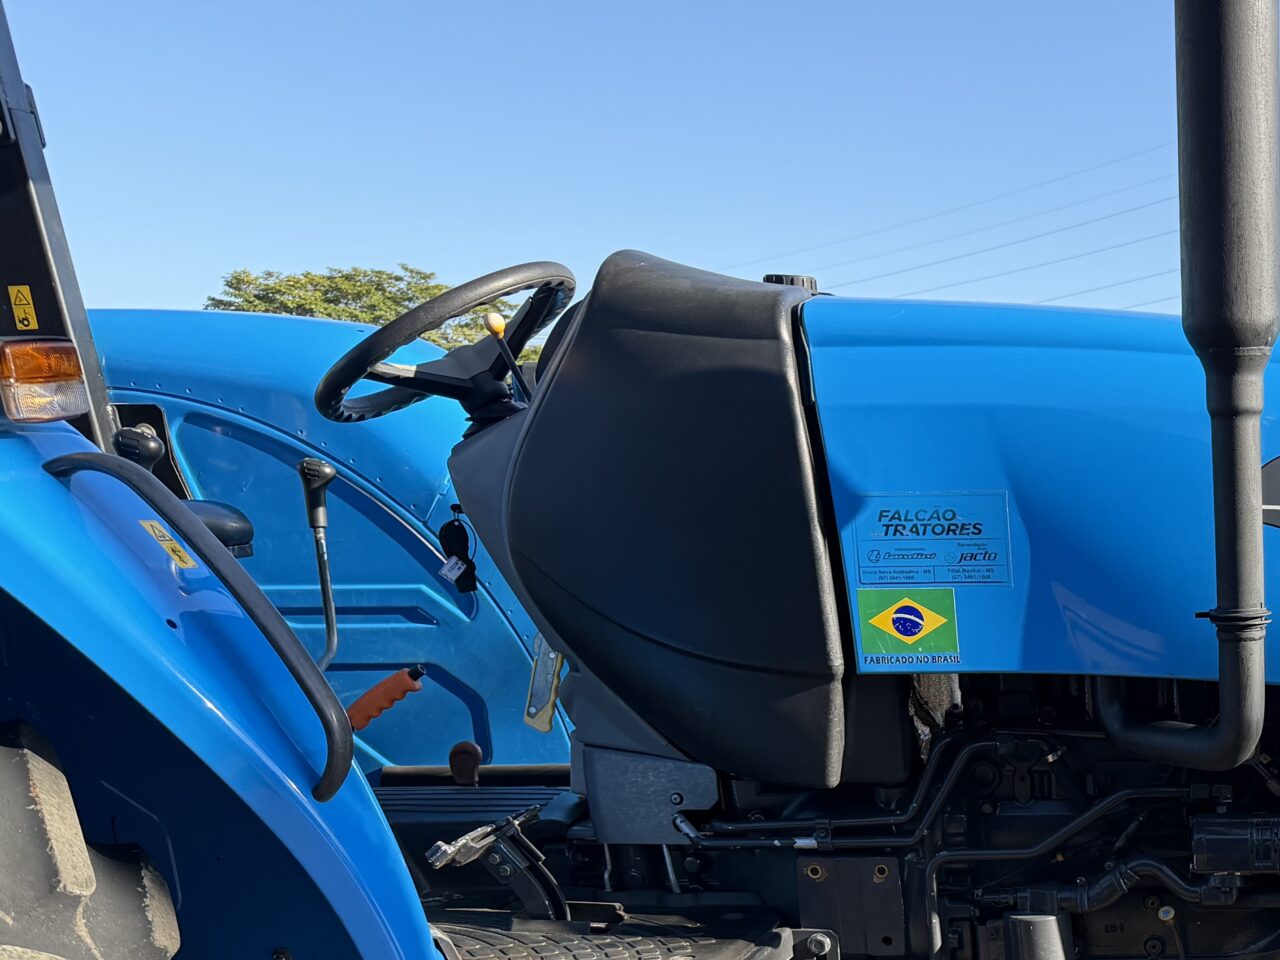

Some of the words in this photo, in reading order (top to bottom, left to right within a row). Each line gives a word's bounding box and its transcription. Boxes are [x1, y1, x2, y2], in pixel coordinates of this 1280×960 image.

[877, 505, 957, 522] FALCÃO
[882, 522, 984, 536] TRATORES
[957, 551, 997, 564] jacto
[864, 655, 914, 664] FABRICADO
[916, 655, 929, 664] NO
[932, 655, 960, 664] BRASIL
